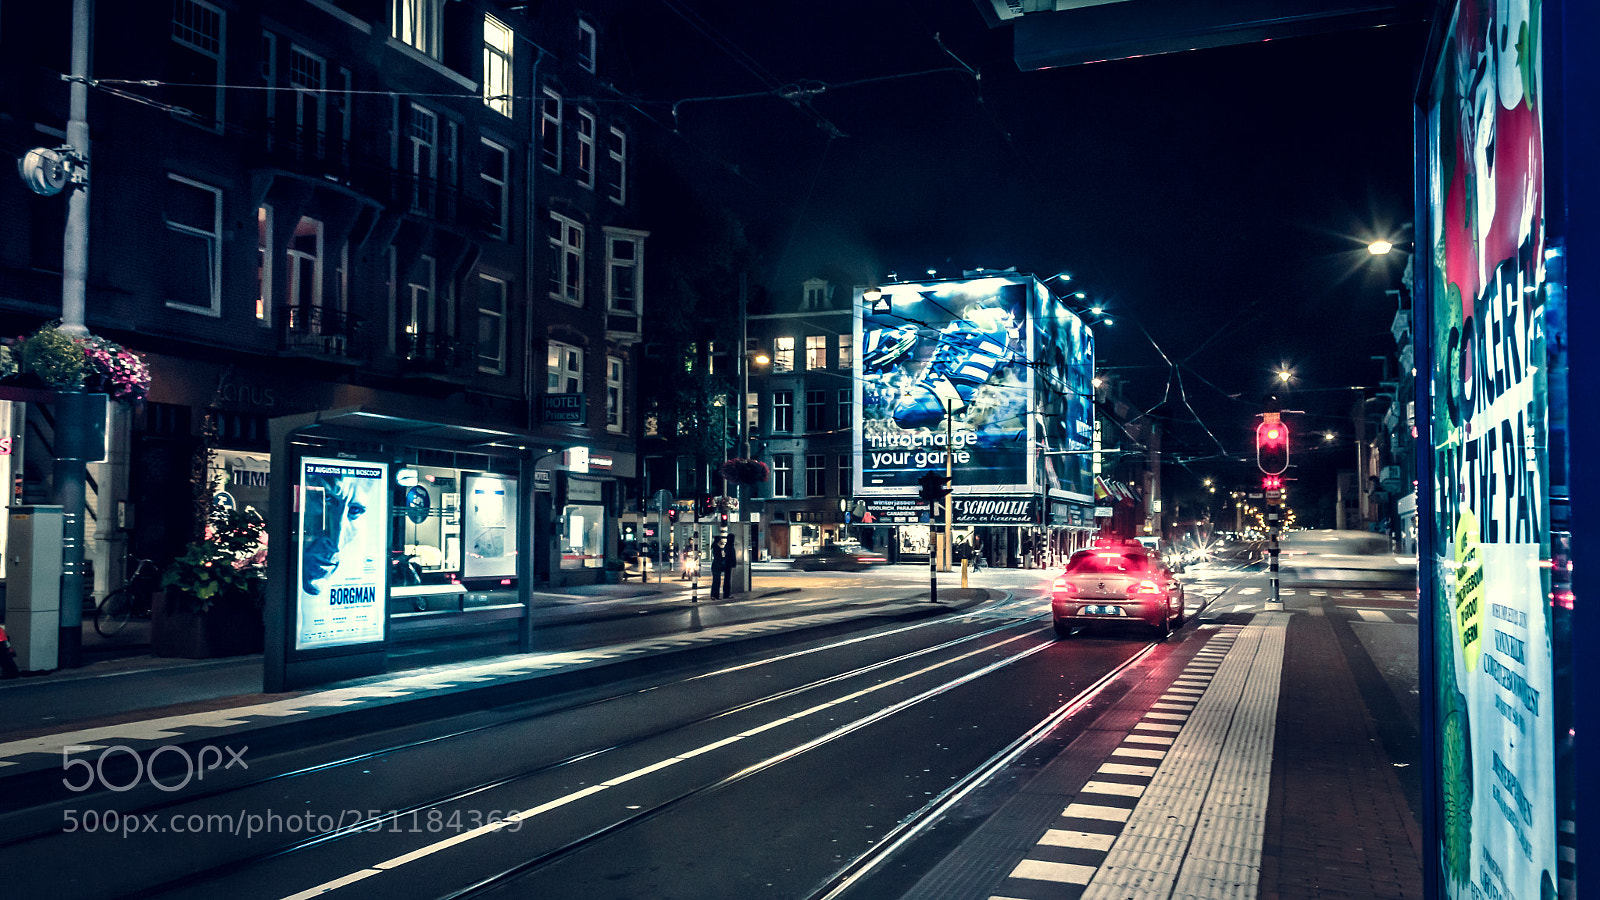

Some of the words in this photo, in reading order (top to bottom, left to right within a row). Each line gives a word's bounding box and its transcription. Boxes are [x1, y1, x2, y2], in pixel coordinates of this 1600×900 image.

[546, 396, 580, 408] HOTEL
[545, 410, 579, 420] Princess
[872, 452, 911, 469] your
[914, 450, 971, 468] game
[1465, 427, 1499, 544] THE
[963, 500, 1032, 515] SCHOOLTJE
[329, 586, 376, 606] BORGMAN
